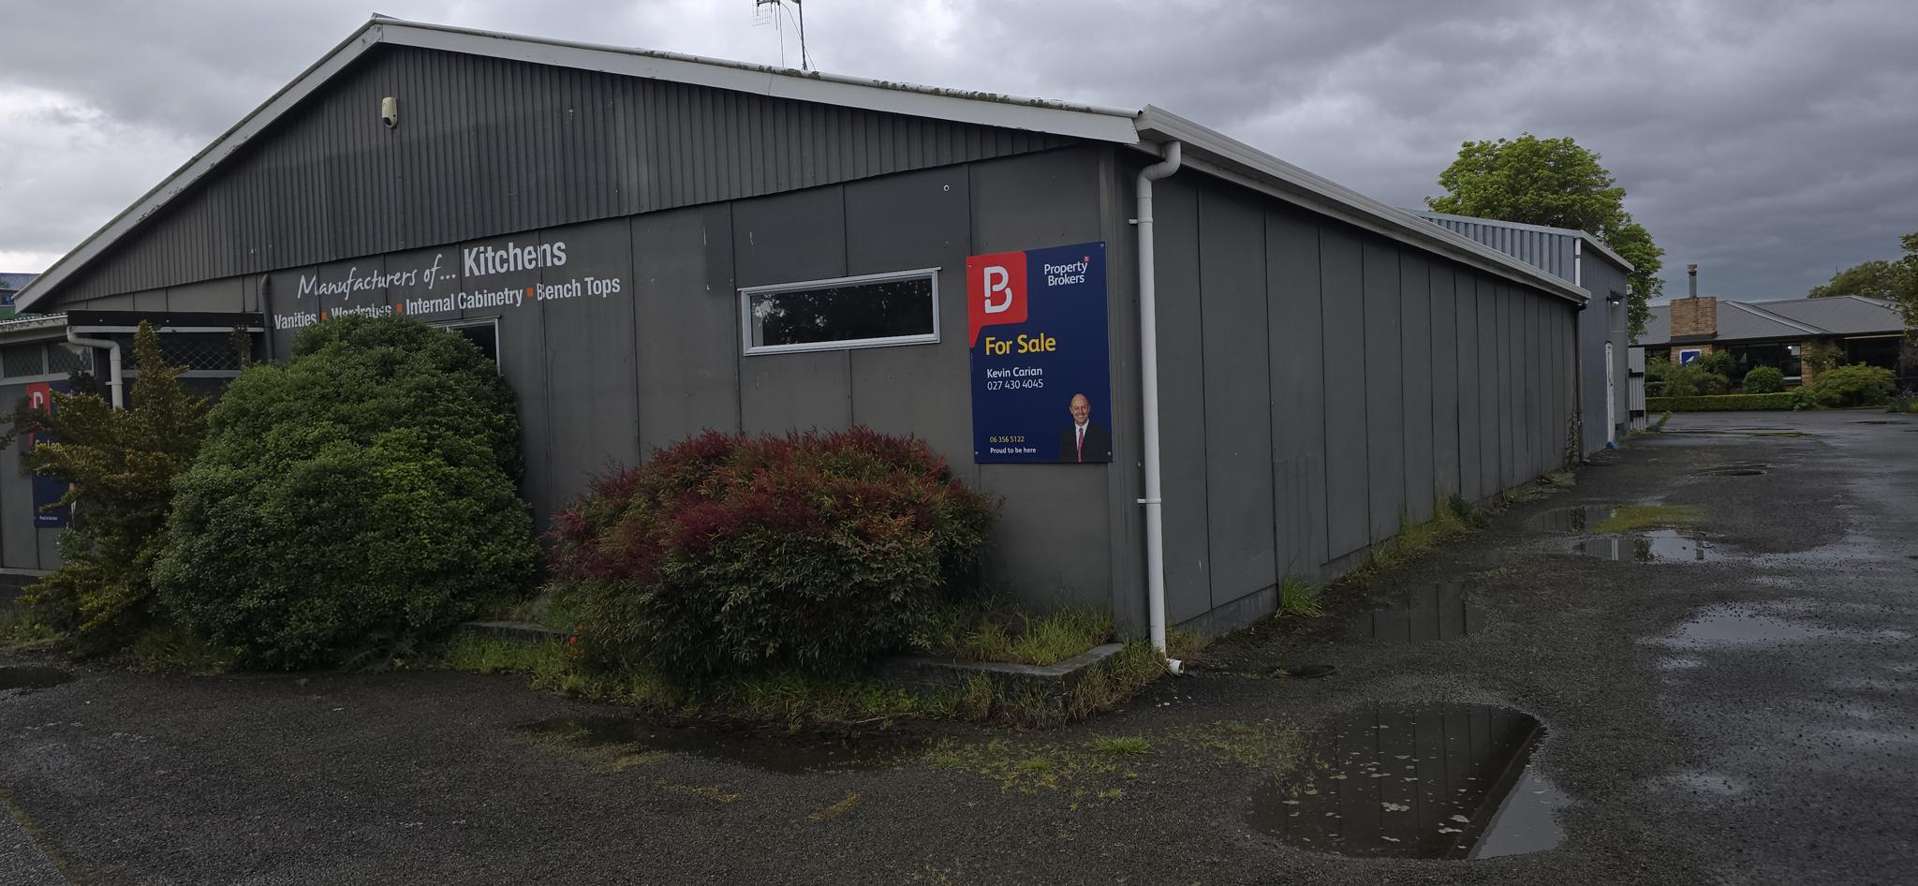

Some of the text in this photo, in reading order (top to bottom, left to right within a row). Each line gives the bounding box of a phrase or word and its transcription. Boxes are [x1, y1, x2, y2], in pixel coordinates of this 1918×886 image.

[298, 240, 568, 300] Manufacturers of... Kitchens
[1044, 259, 1088, 276] Property
[1048, 274, 1086, 287] Brokers
[273, 311, 318, 330] Vanities
[405, 297, 455, 316] Internal
[458, 288, 523, 313] Cabinetry
[536, 279, 581, 302] Bench
[584, 276, 621, 298] Tops
[984, 332, 1056, 356] For Sale
[987, 366, 1043, 379] Kevin Carian
[987, 379, 1044, 391] 027 430 4045
[990, 446, 1007, 454] Proud
[1015, 446, 1022, 454] be
[1023, 446, 1036, 454] here
